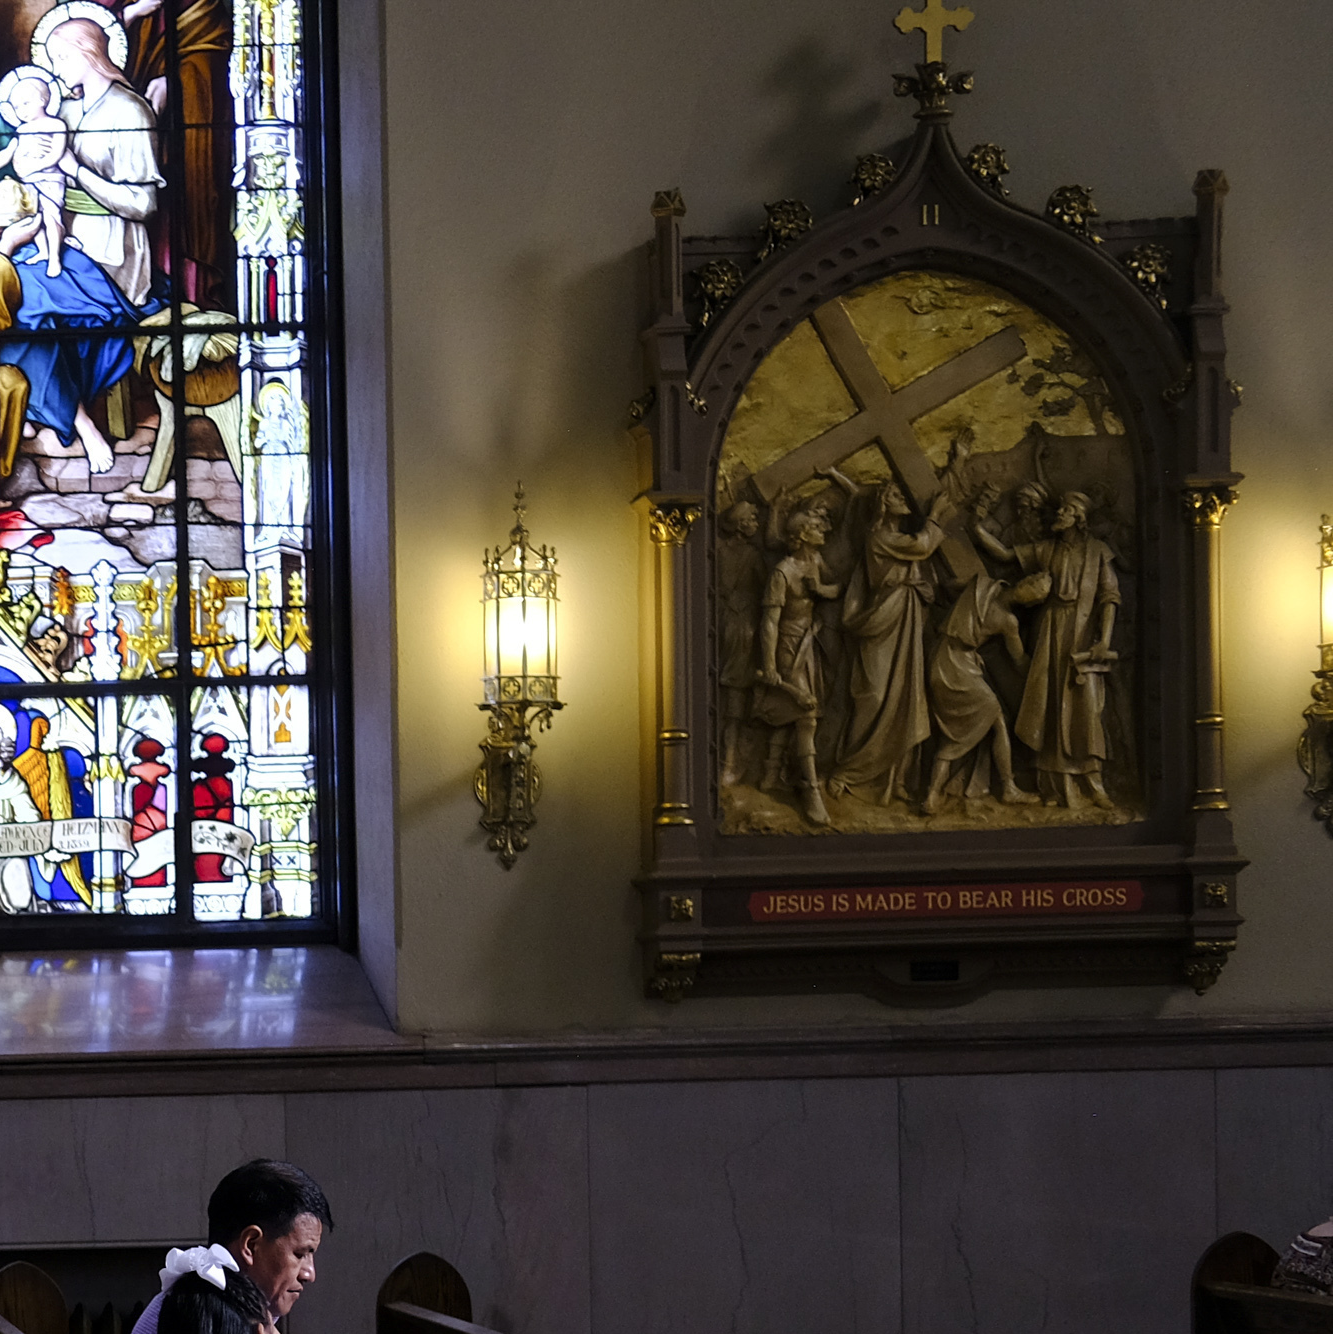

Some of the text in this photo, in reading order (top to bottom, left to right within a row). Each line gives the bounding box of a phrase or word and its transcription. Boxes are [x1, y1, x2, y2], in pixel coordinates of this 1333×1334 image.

[922, 204, 940, 226] II
[763, 888, 1127, 913] JESUS IS MADE TO BEAR HIS CROSS
